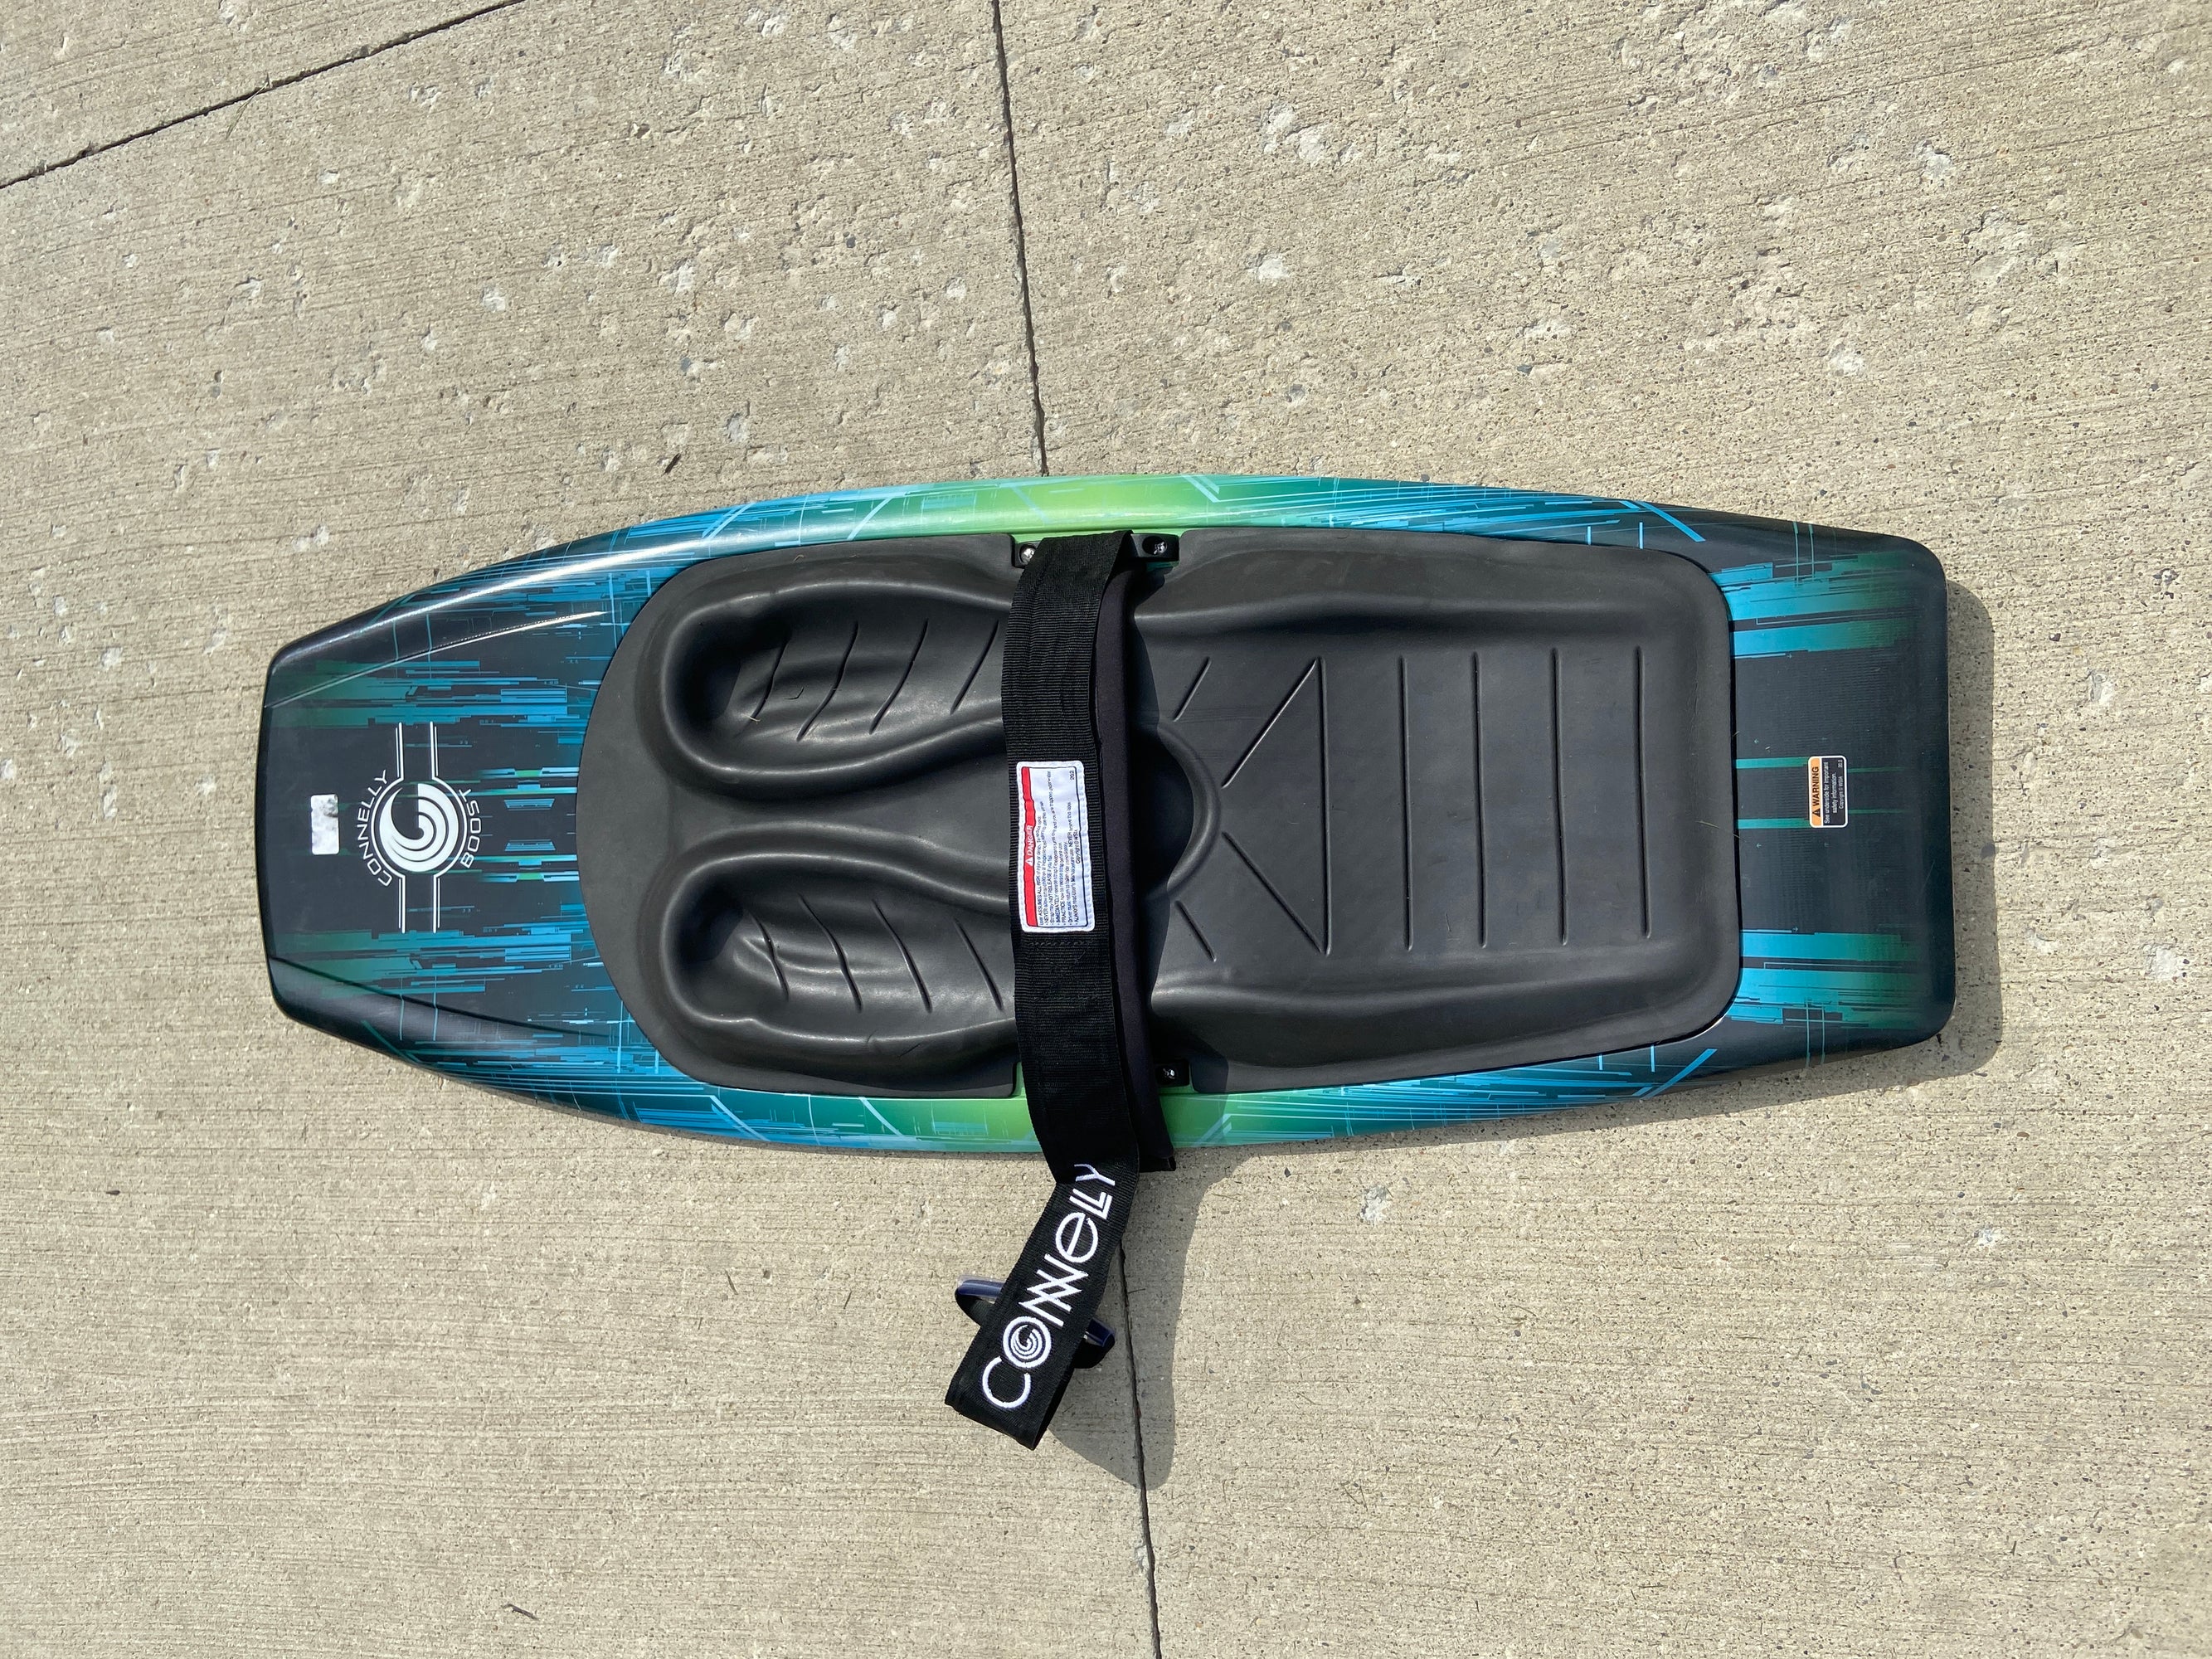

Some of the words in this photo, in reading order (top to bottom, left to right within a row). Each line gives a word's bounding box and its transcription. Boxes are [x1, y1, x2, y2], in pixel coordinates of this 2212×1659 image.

[1811, 766, 1820, 807] WARNING
[357, 769, 392, 887] CONNELLY
[459, 788, 482, 868] BOOST
[1026, 825, 1034, 856] DANGER
